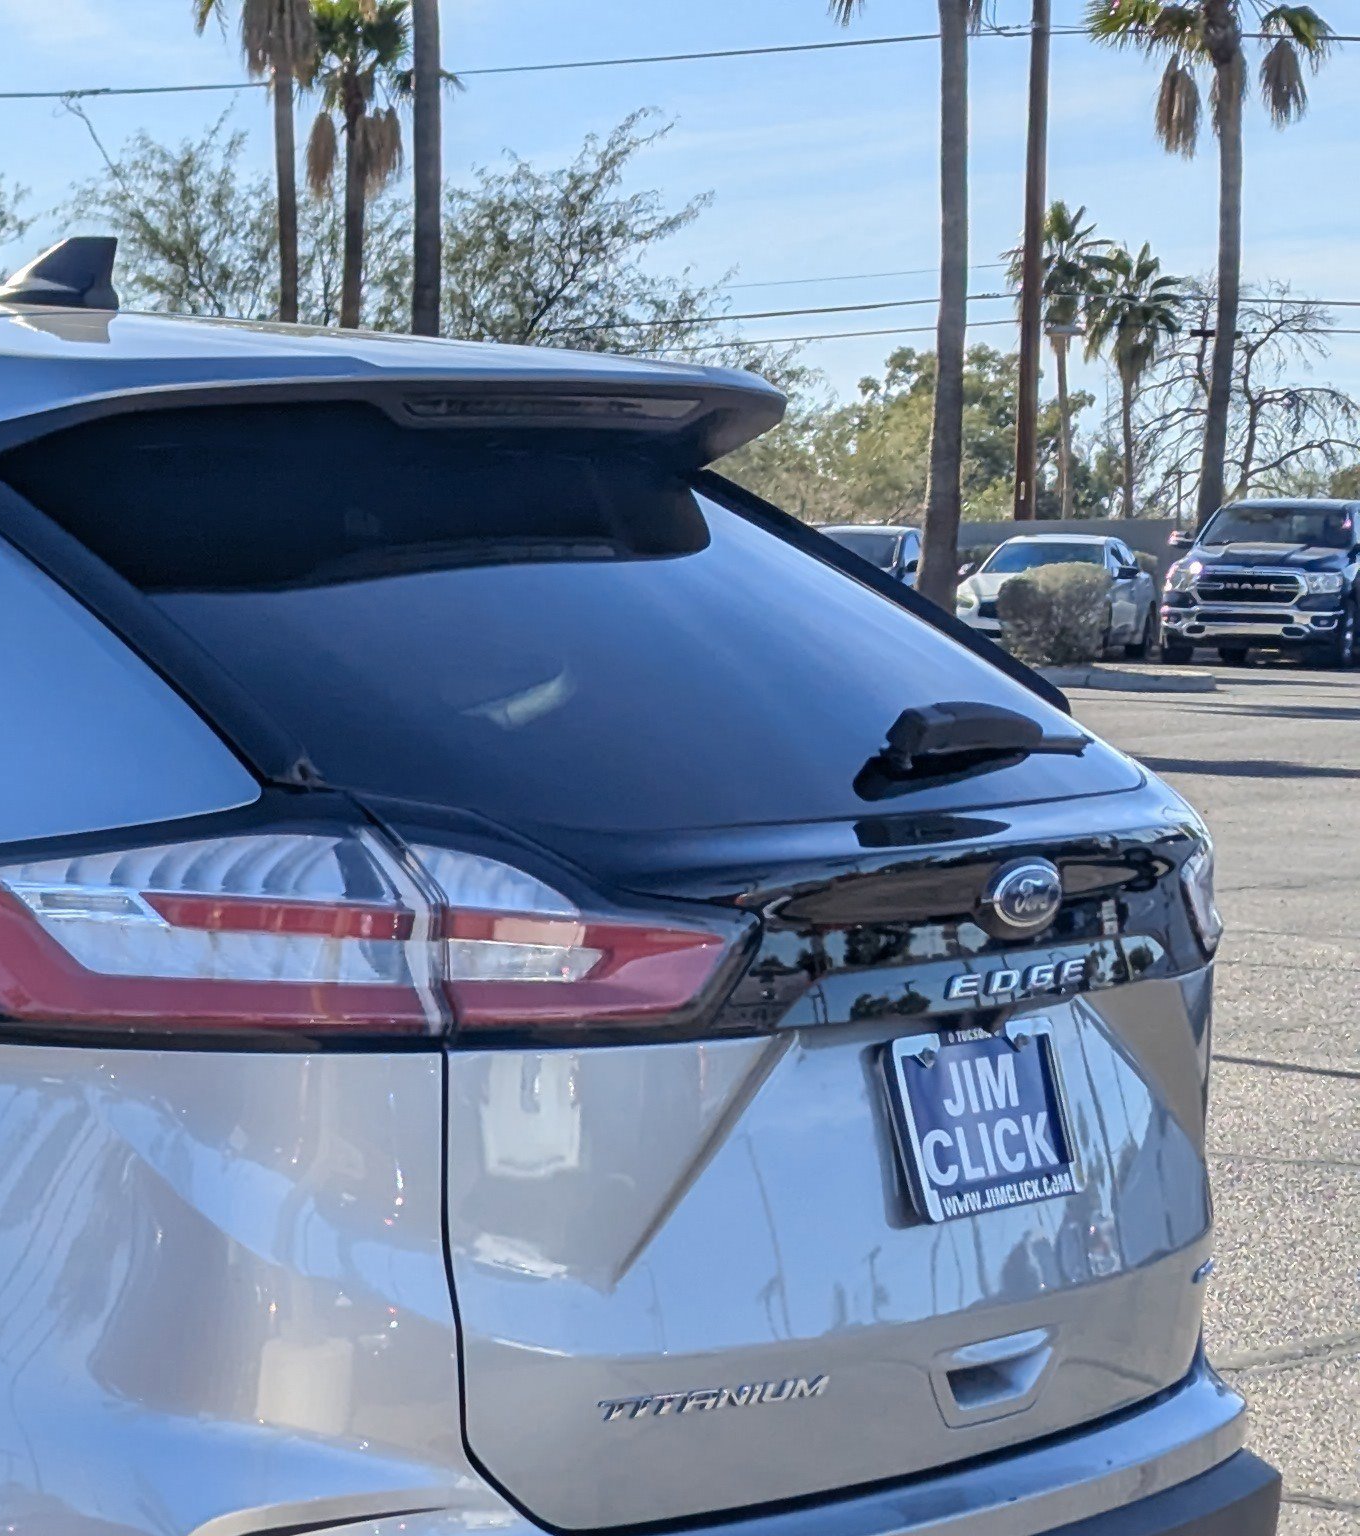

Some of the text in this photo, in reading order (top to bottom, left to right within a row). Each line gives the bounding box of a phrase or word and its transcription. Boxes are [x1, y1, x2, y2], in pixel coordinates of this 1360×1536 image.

[1225, 582, 1269, 591] RAM
[943, 957, 1086, 1001] EDGE
[943, 1053, 1020, 1118] JIM
[921, 1111, 1060, 1187] CLICK
[942, 1172, 1073, 1218] WWW.JIMCLICK.COM
[596, 1374, 830, 1422] TITANIUM
